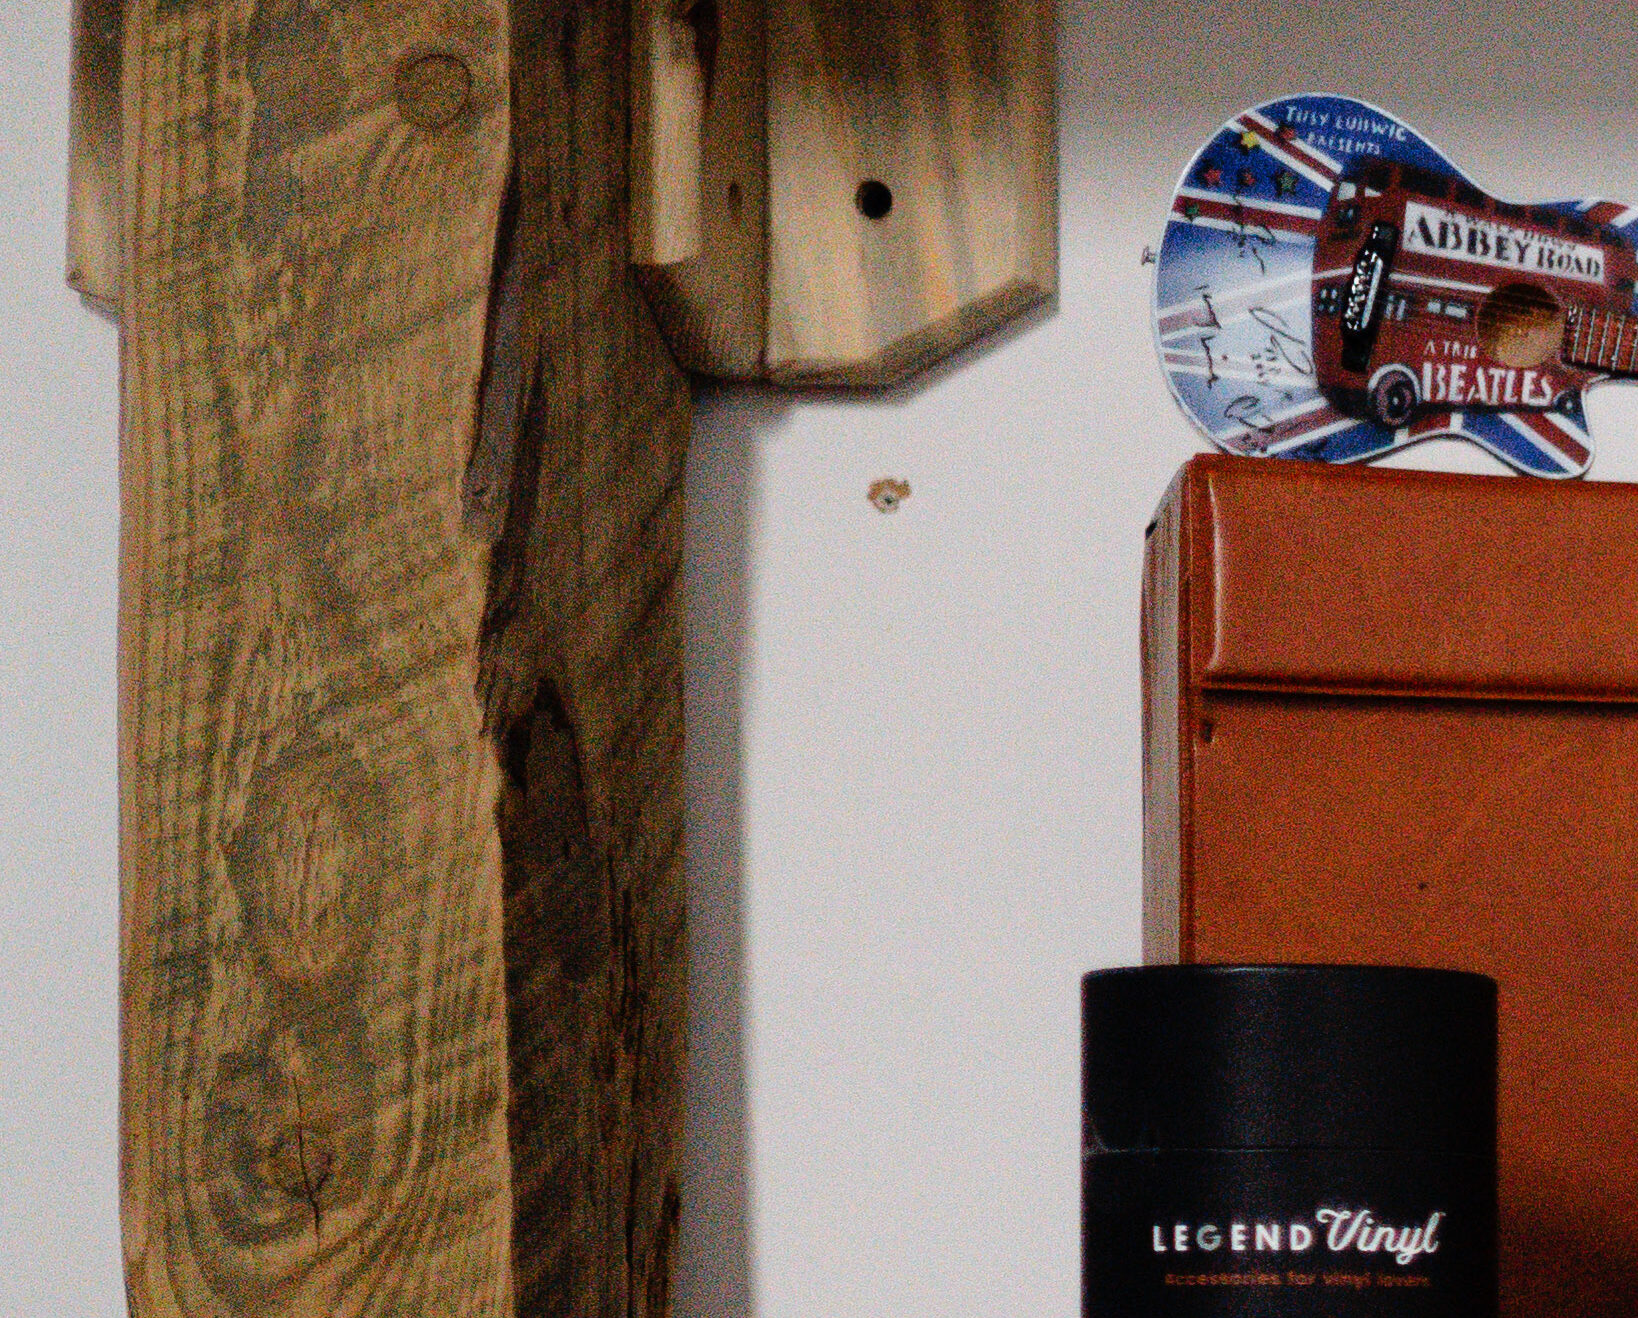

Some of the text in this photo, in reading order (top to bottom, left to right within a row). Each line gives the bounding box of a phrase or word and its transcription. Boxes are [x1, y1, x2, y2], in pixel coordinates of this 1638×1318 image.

[1407, 214, 1530, 263] ABBEY
[1538, 247, 1600, 276] ROAD
[1423, 362, 1552, 406] BEATLES
[1152, 1207, 1446, 1265] LEGEND Vinyl
